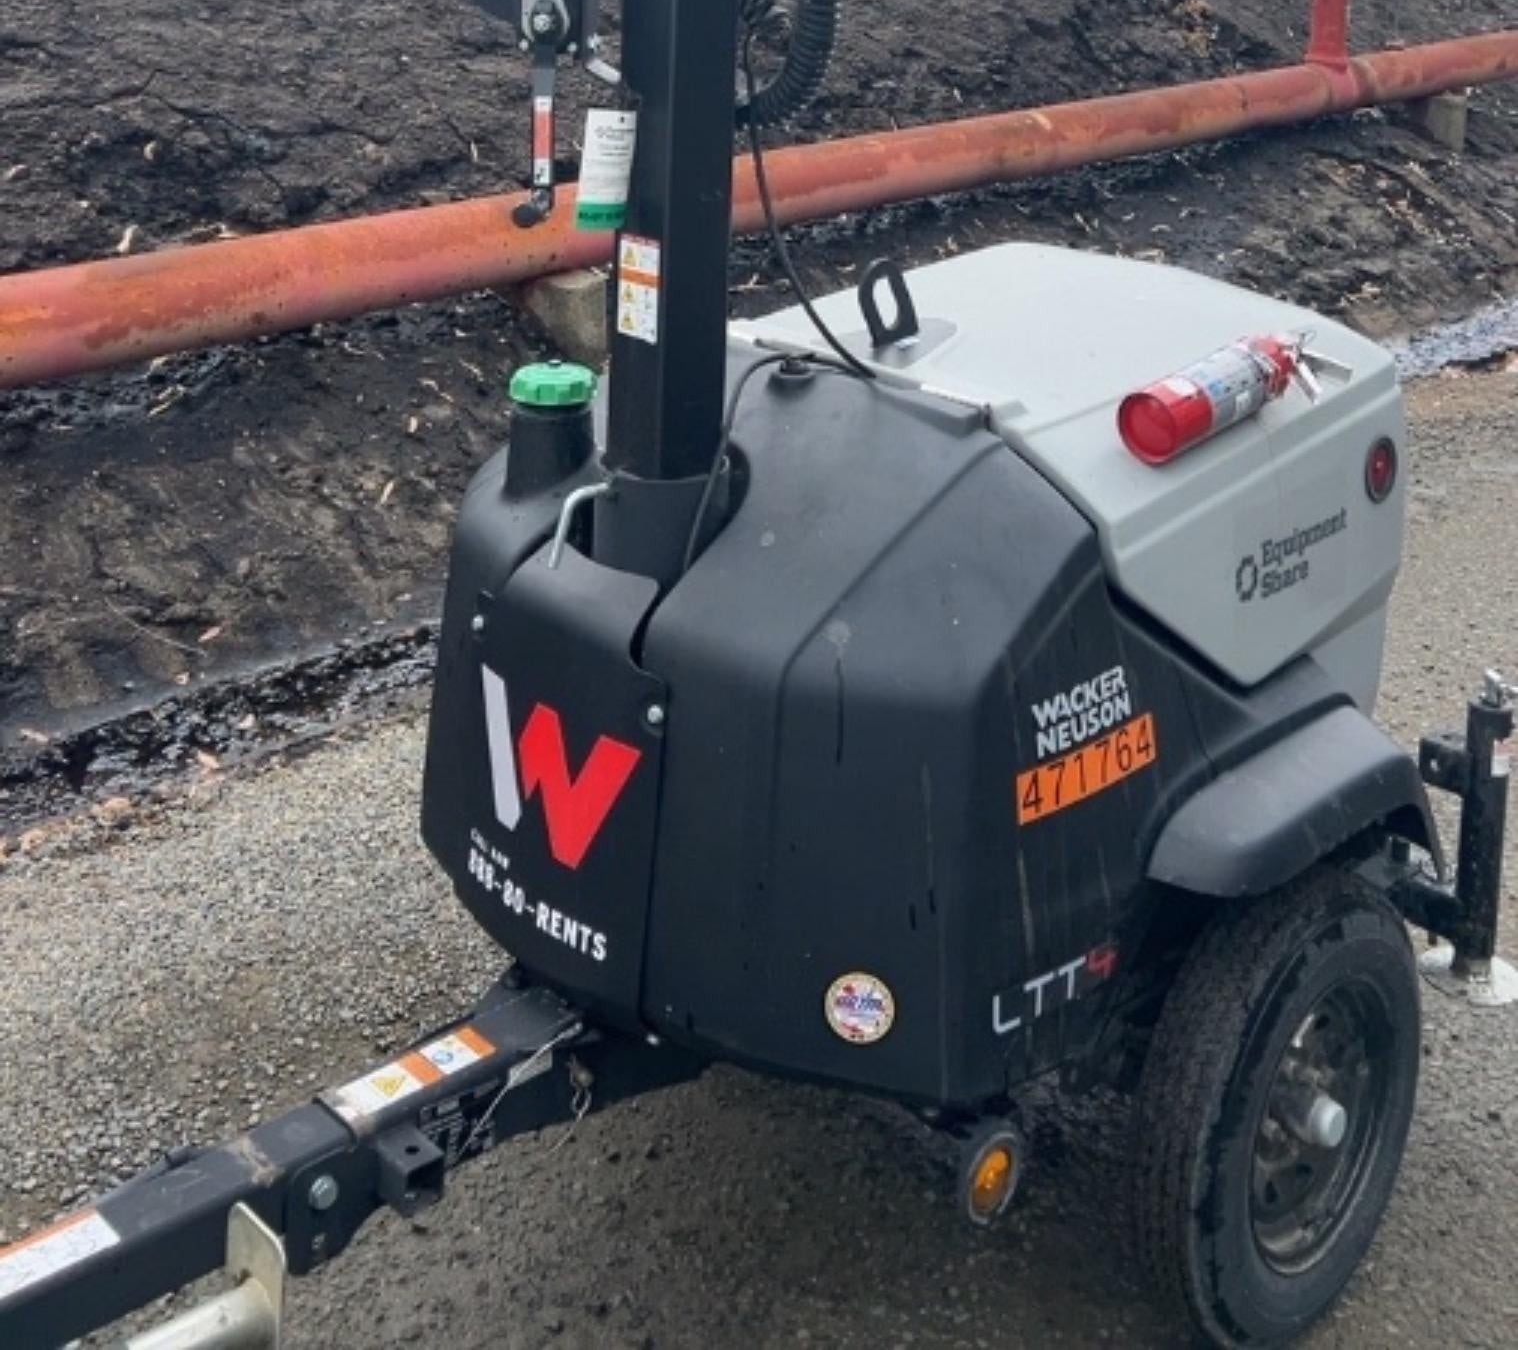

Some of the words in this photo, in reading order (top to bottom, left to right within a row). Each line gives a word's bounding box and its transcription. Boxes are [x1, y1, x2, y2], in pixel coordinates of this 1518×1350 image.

[1261, 507, 1347, 567] Equipment
[1261, 559, 1309, 599] Share
[1031, 665, 1126, 729] WACKER
[1037, 690, 1132, 759] NEUSON
[1022, 719, 1151, 813] 471764
